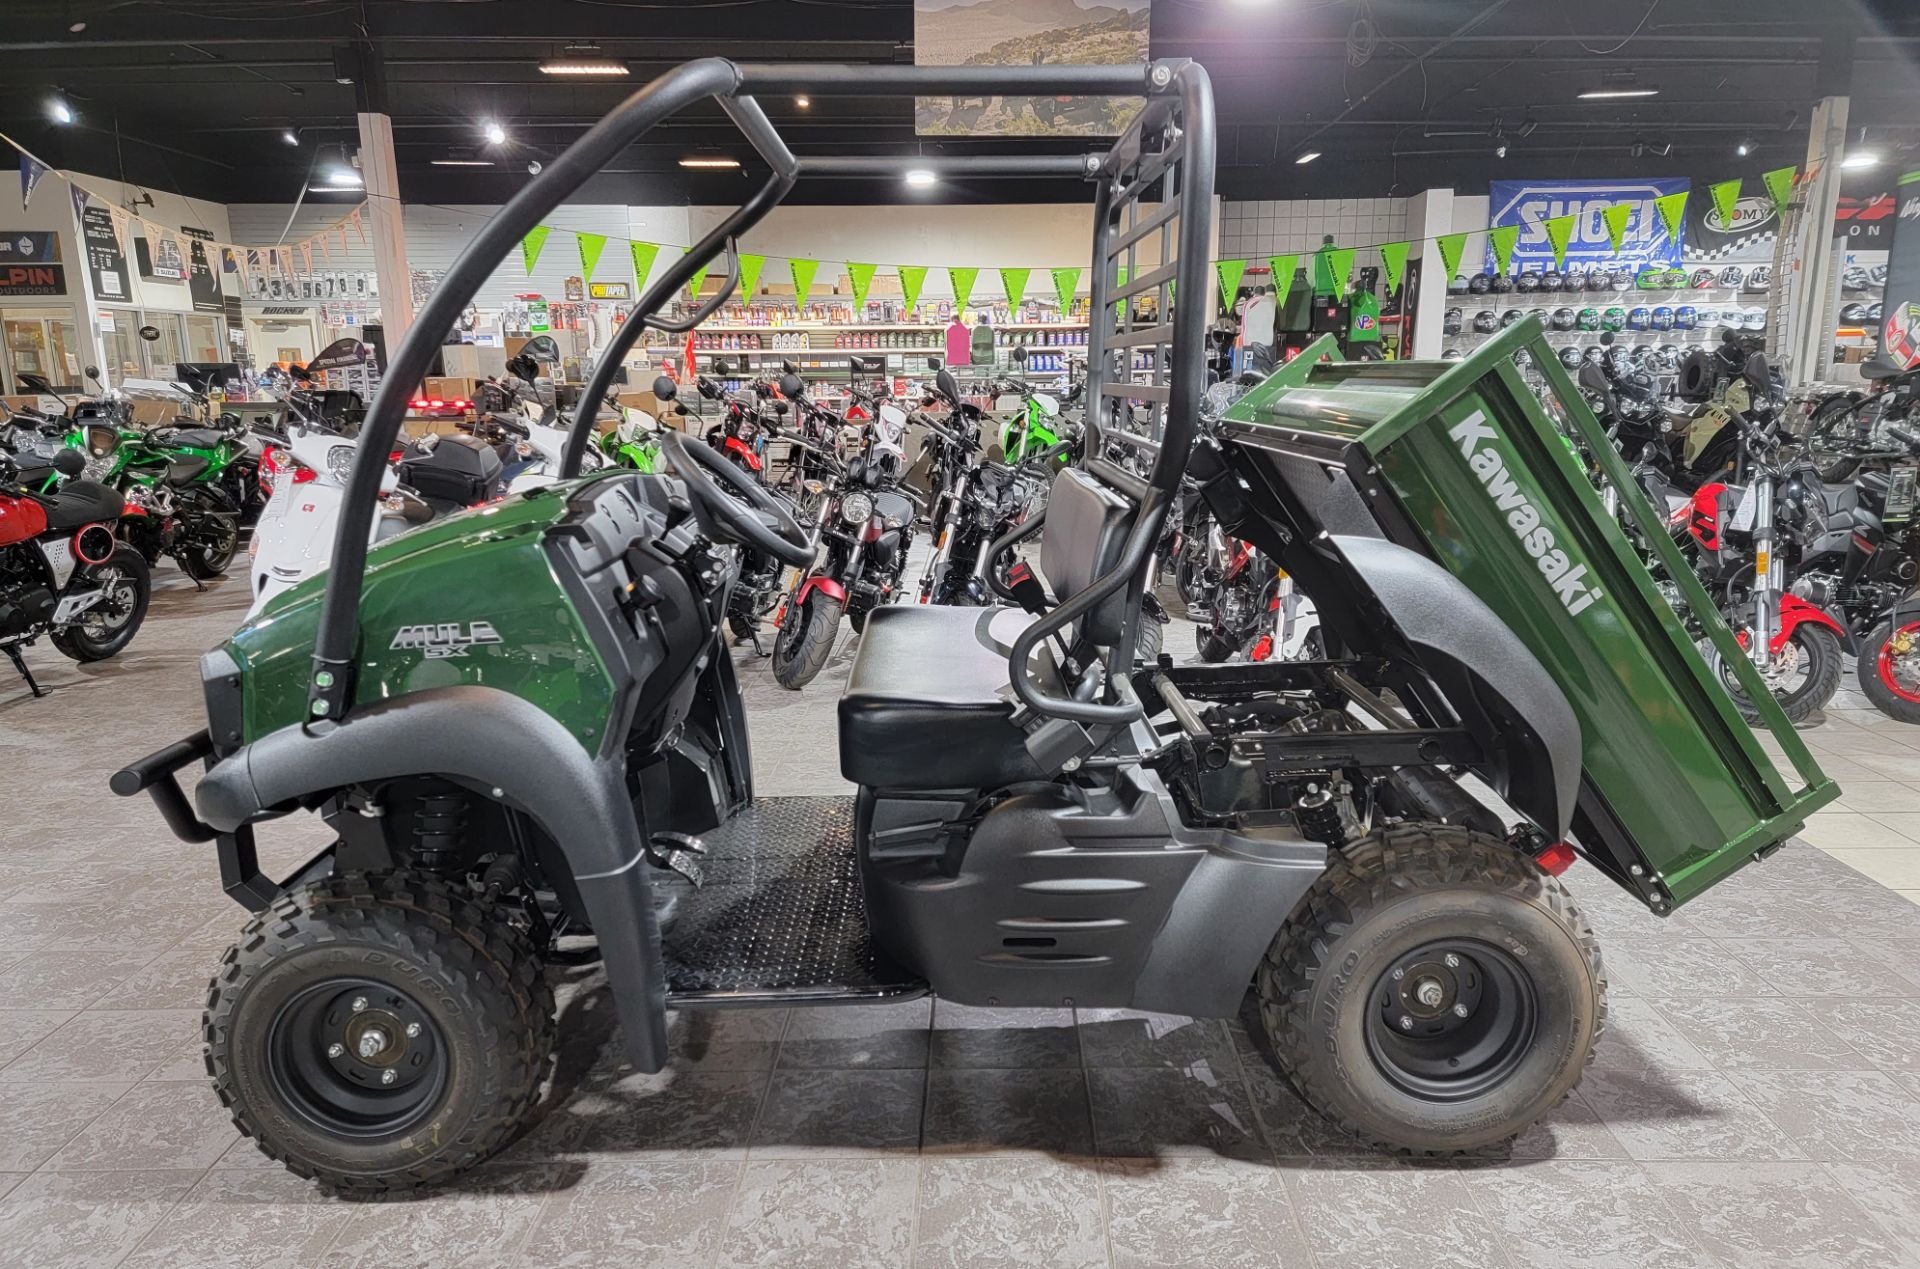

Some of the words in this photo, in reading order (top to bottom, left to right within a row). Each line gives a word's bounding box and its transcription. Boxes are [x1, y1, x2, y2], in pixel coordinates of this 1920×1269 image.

[1520, 200, 1655, 244] SHOEI
[1712, 208, 1770, 220] SOMY
[1327, 255, 1340, 287] Kawasaki
[1494, 260, 1672, 276] HELMETS
[1448, 409, 1604, 617] Kawasaki
[389, 621, 504, 650] MULE
[424, 645, 470, 659] SX
[361, 950, 462, 1017] DURO
